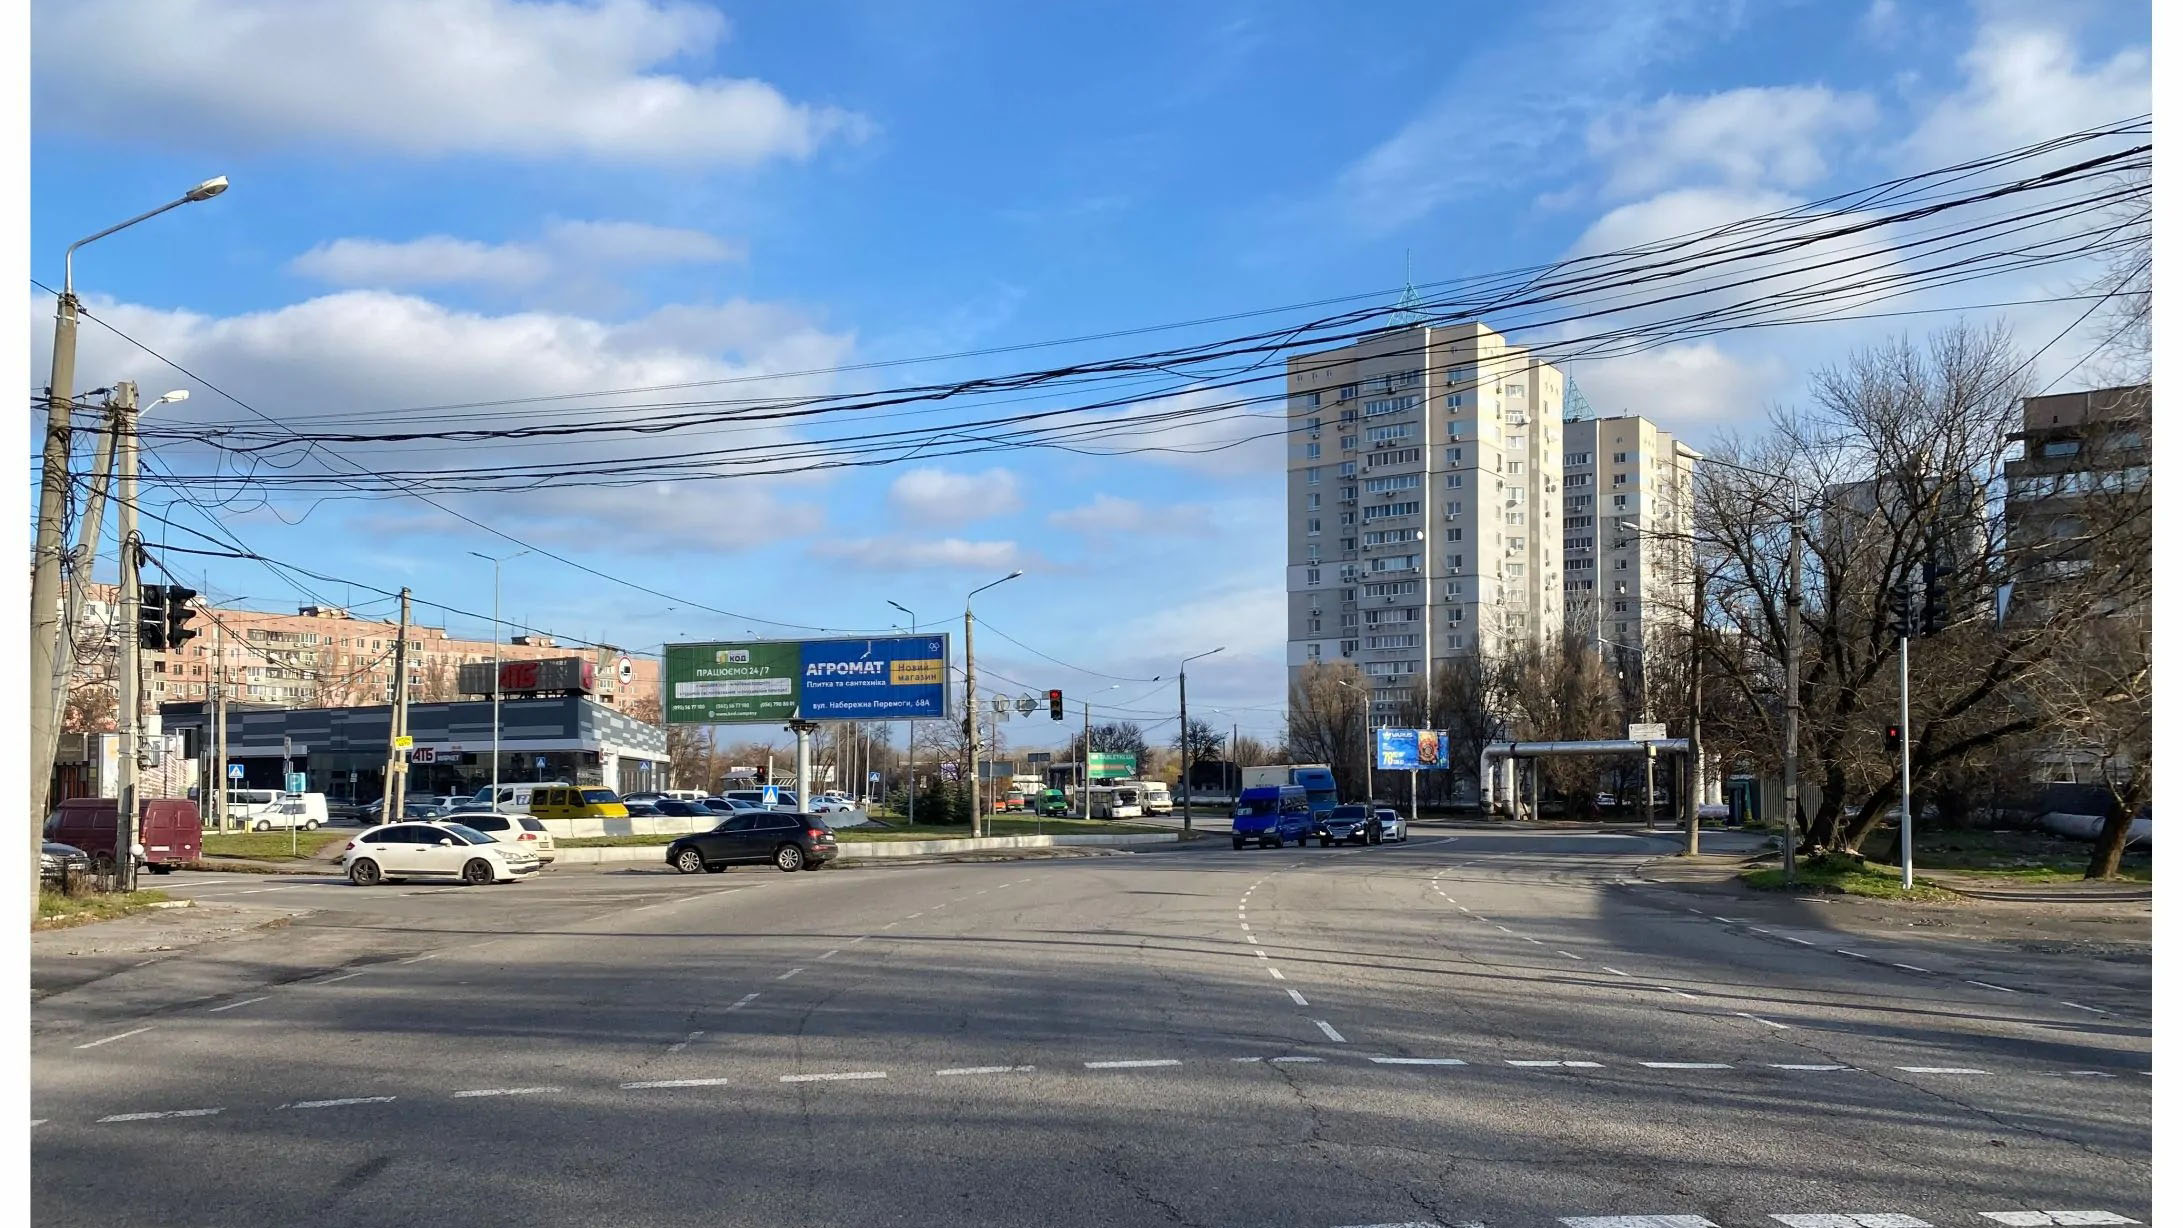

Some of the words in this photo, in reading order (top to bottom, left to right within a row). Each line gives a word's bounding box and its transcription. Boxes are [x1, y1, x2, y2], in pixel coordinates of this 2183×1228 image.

[697, 667, 747, 676] ПРАЦЮЄМО
[807, 662, 884, 675] АГРОМАТ
[898, 663, 929, 672] Новий
[898, 674, 936, 682] магазин
[806, 680, 834, 688] Плитка
[812, 703, 827, 711] вул.
[830, 701, 871, 709] Набережна
[873, 700, 913, 709] Перемоги,
[413, 748, 434, 761] АТБ
